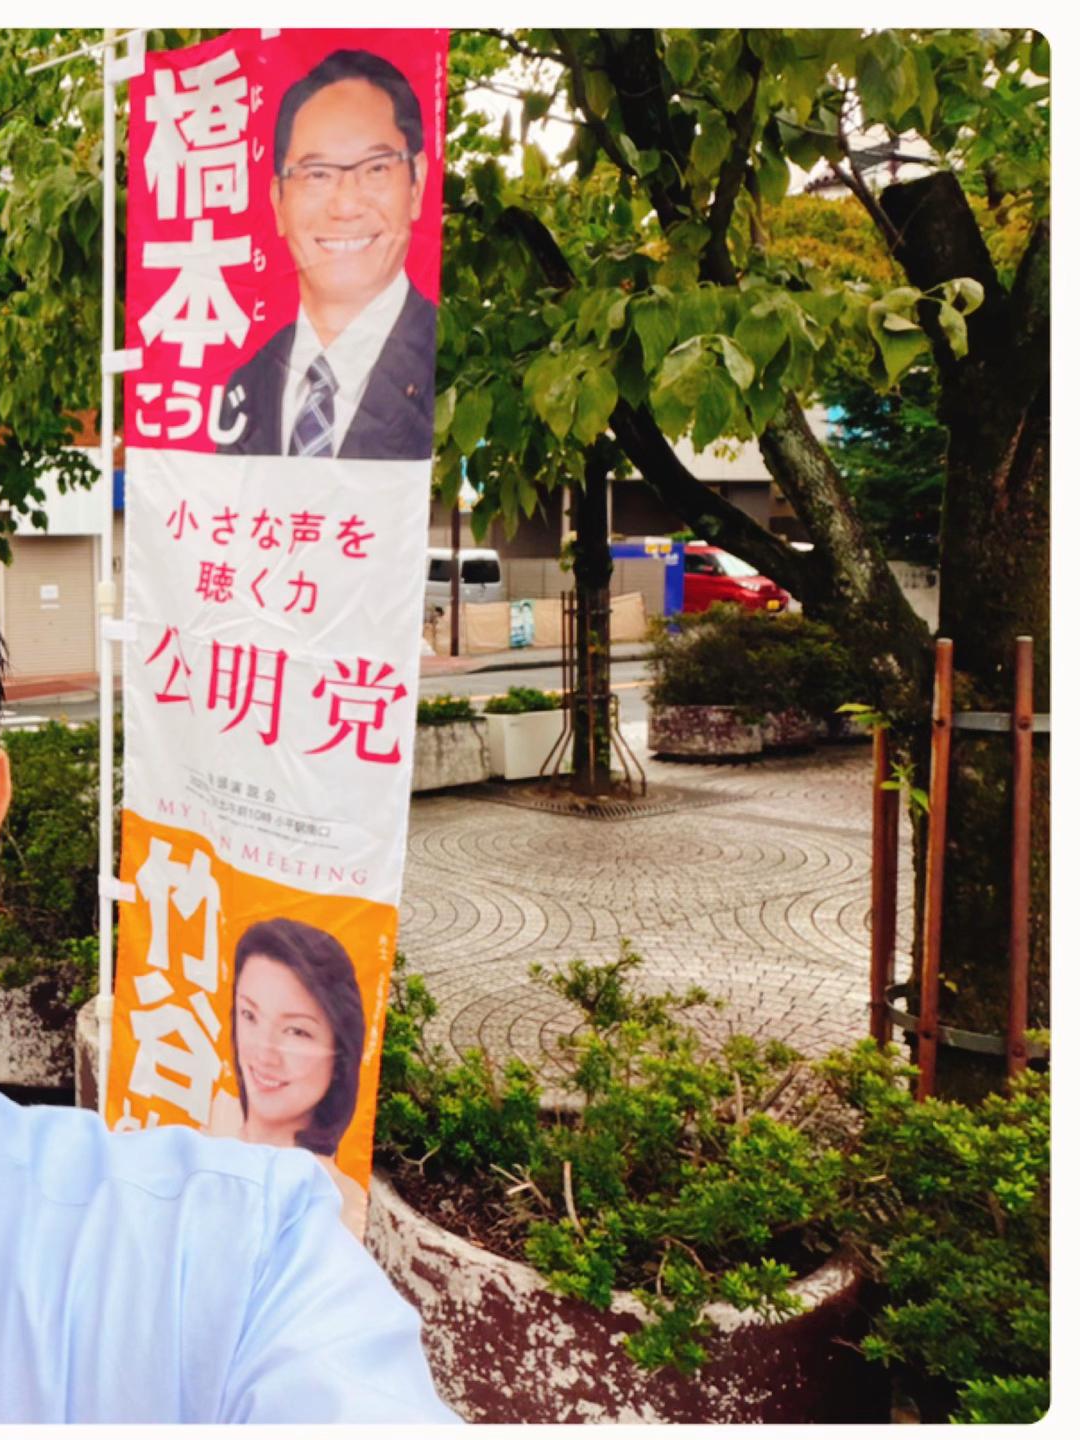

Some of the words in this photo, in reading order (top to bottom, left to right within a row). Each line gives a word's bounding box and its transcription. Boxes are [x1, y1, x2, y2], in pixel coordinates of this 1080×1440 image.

[138, 49, 251, 368] 橋本
[135, 381, 247, 444] こうじ
[166, 499, 375, 559] 小さな声を
[196, 561, 318, 615] 聴く力
[144, 623, 408, 765] 公明党
[158, 798, 191, 817] MY
[241, 844, 368, 886] MEETING
[128, 836, 221, 1127] 竹谷
